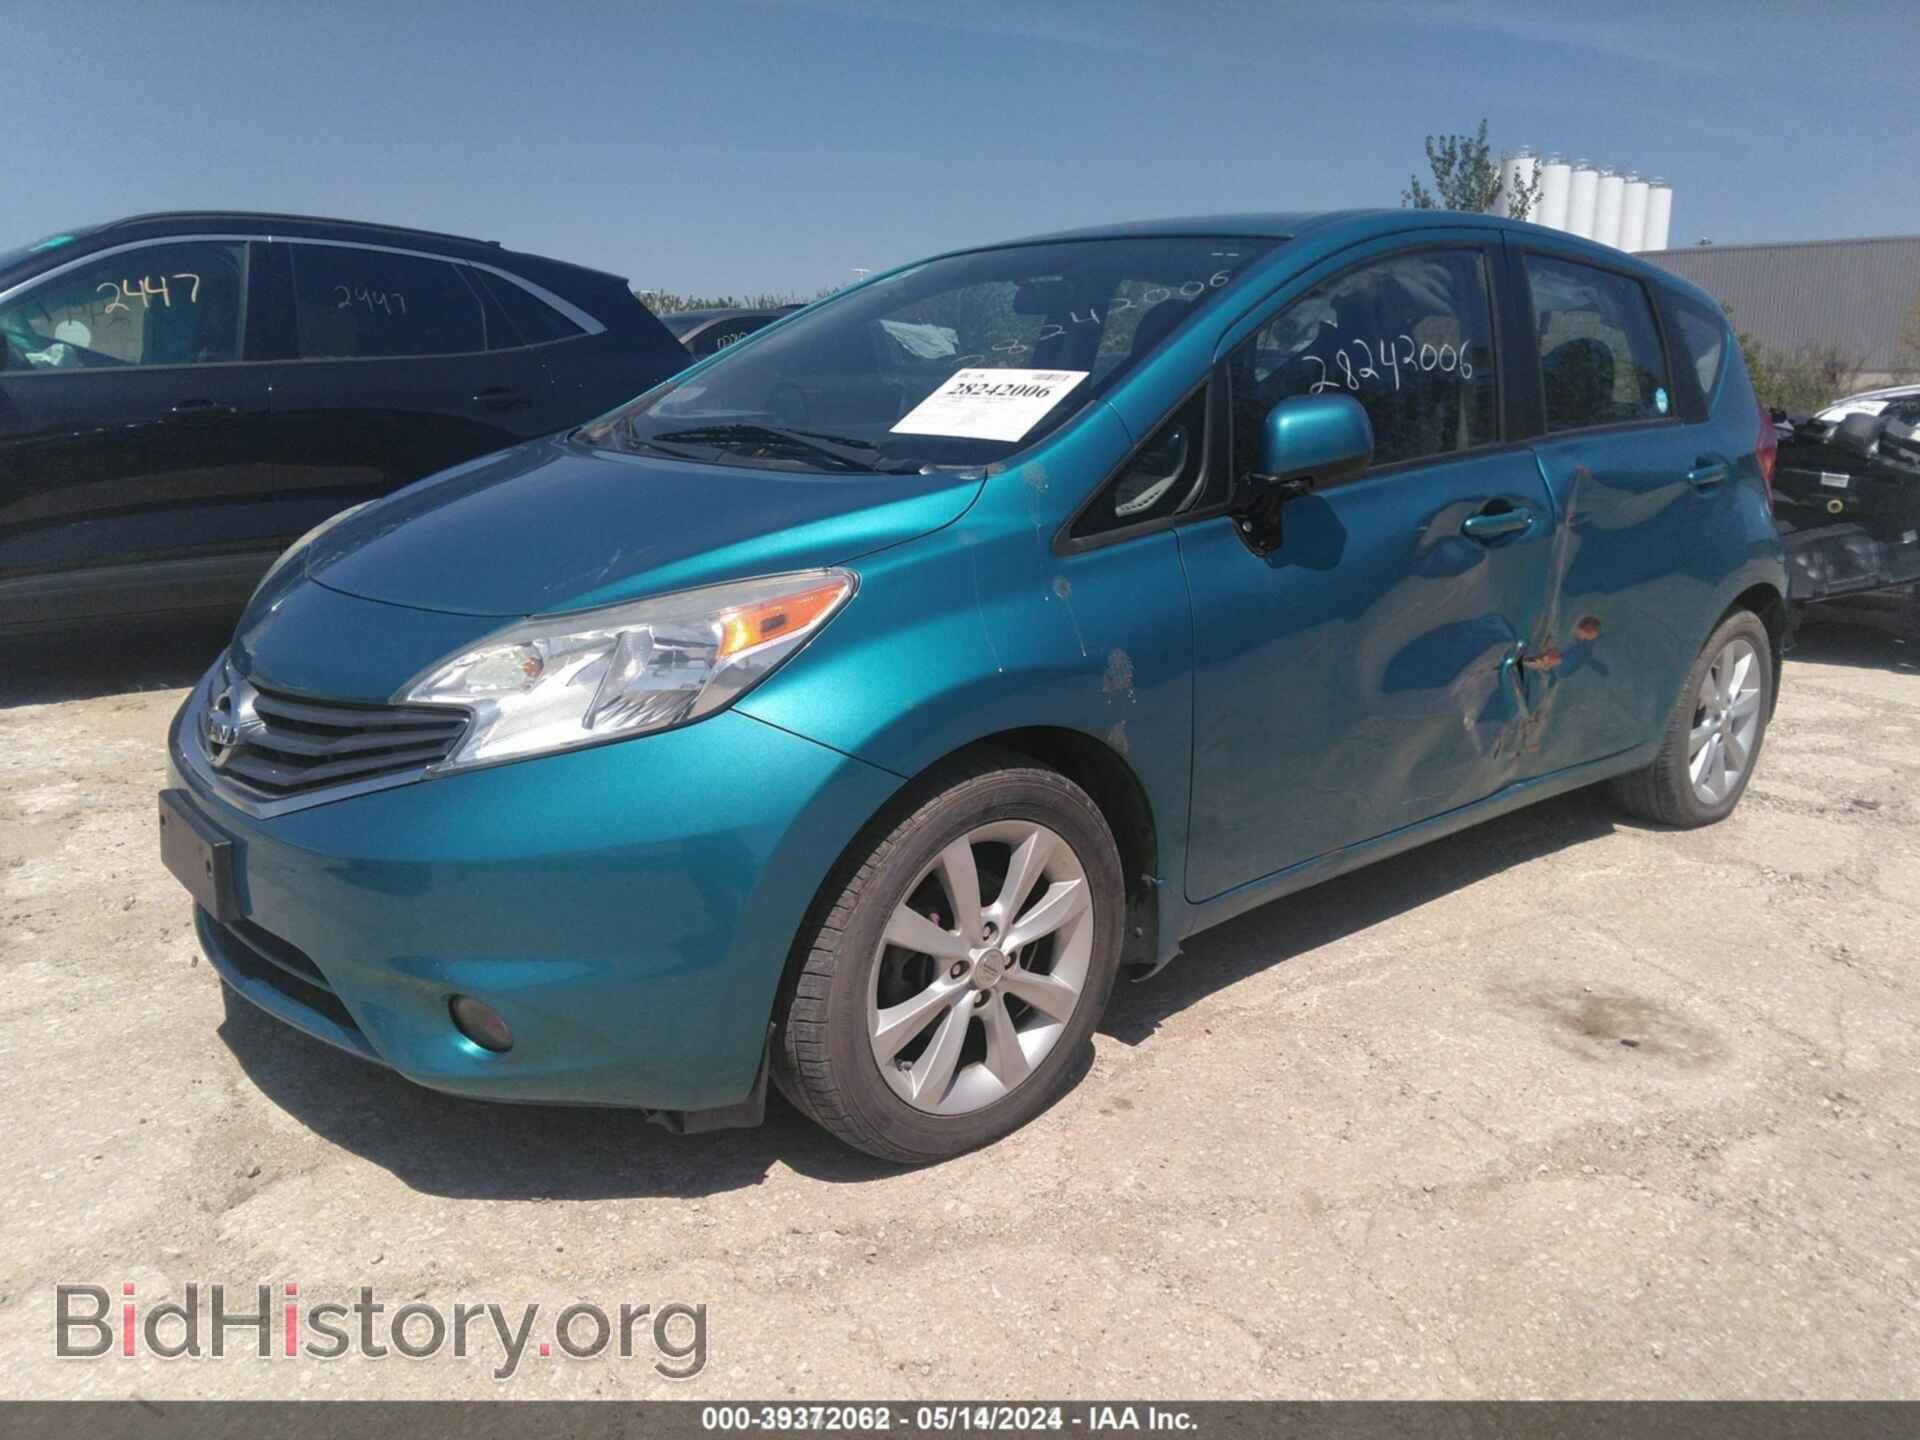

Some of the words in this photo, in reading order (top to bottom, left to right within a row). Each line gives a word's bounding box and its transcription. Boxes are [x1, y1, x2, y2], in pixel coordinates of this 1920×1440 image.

[96, 273, 200, 314] 2447
[334, 285, 406, 315] 2447
[1301, 334, 1473, 394] 28242006
[947, 383, 1051, 399] 28242006
